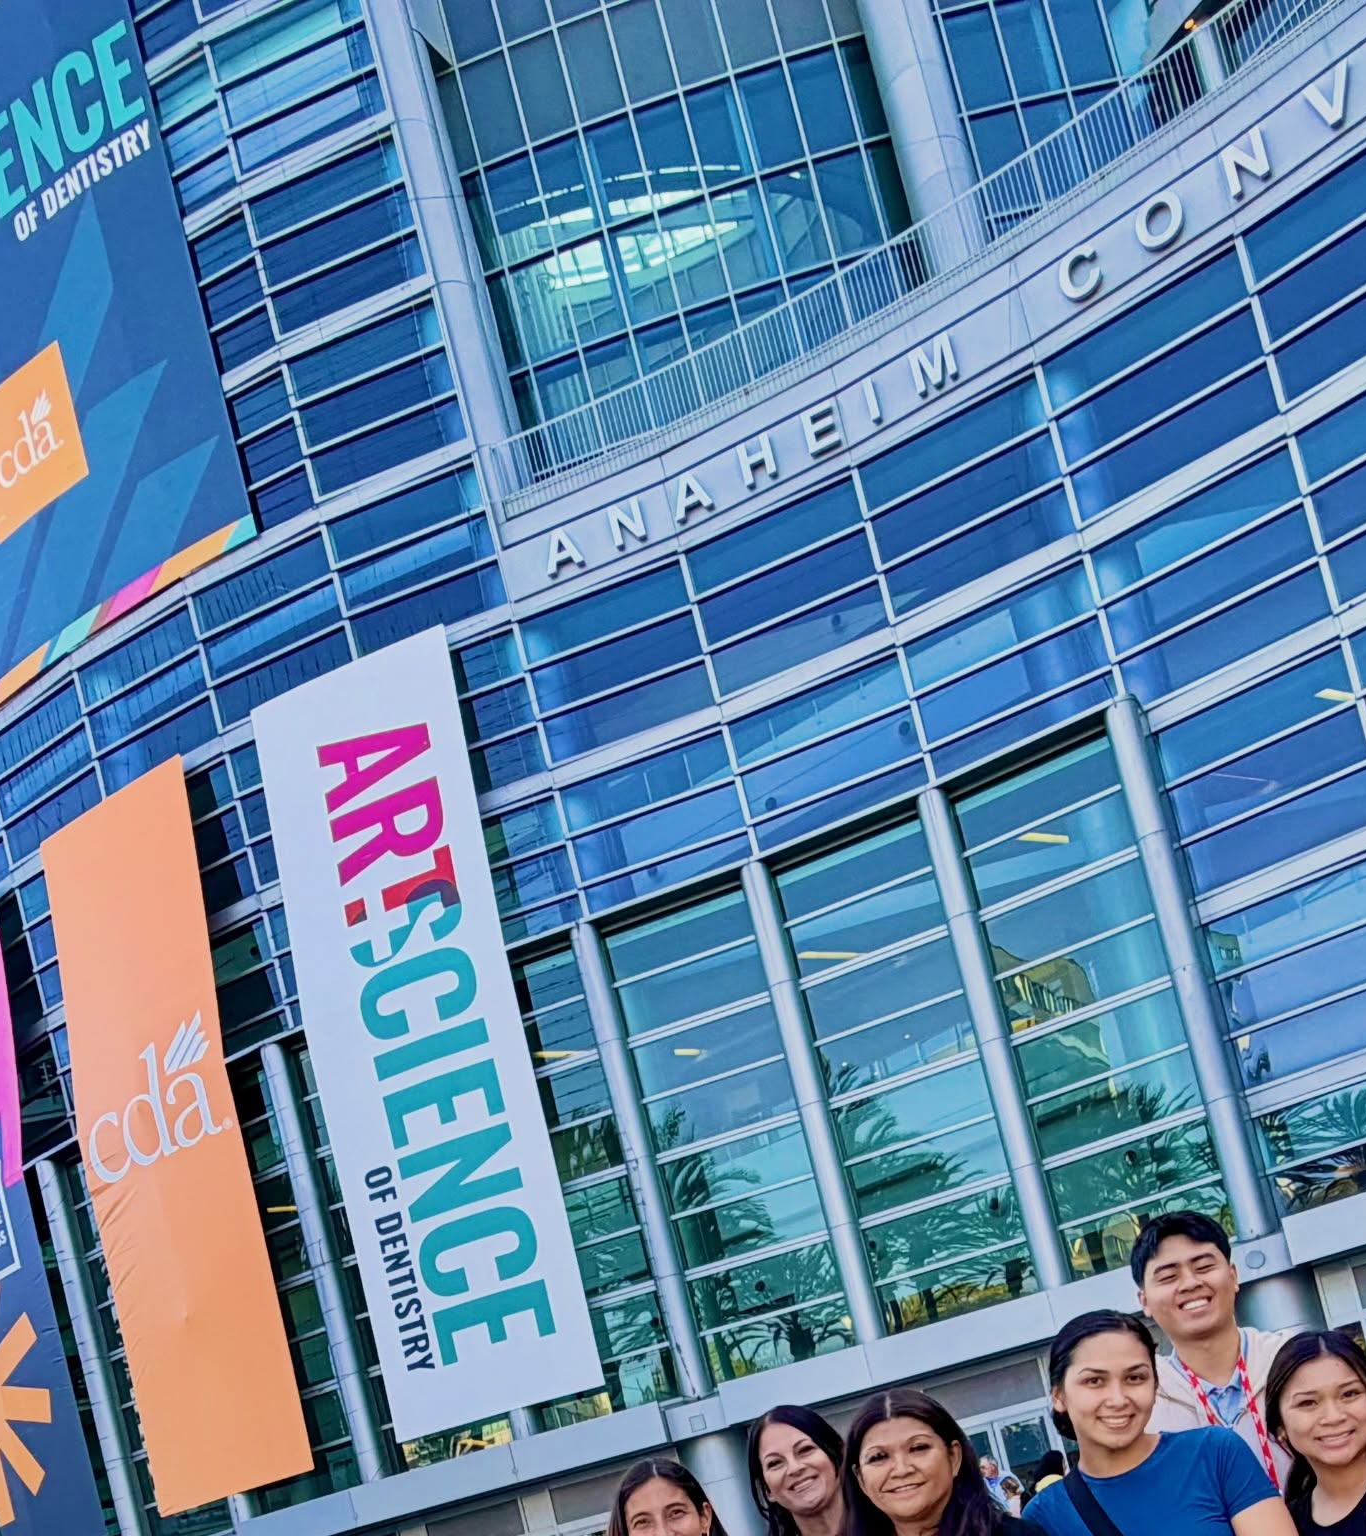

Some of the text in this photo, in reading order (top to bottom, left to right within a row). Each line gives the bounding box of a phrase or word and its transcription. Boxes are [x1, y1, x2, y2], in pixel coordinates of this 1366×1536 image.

[13, 119, 152, 242] OF DENTISTRY
[547, 331, 960, 578] ANAHEIM
[89, 1041, 223, 1183] cda
[364, 1165, 436, 1374] OF DENTISTRY
